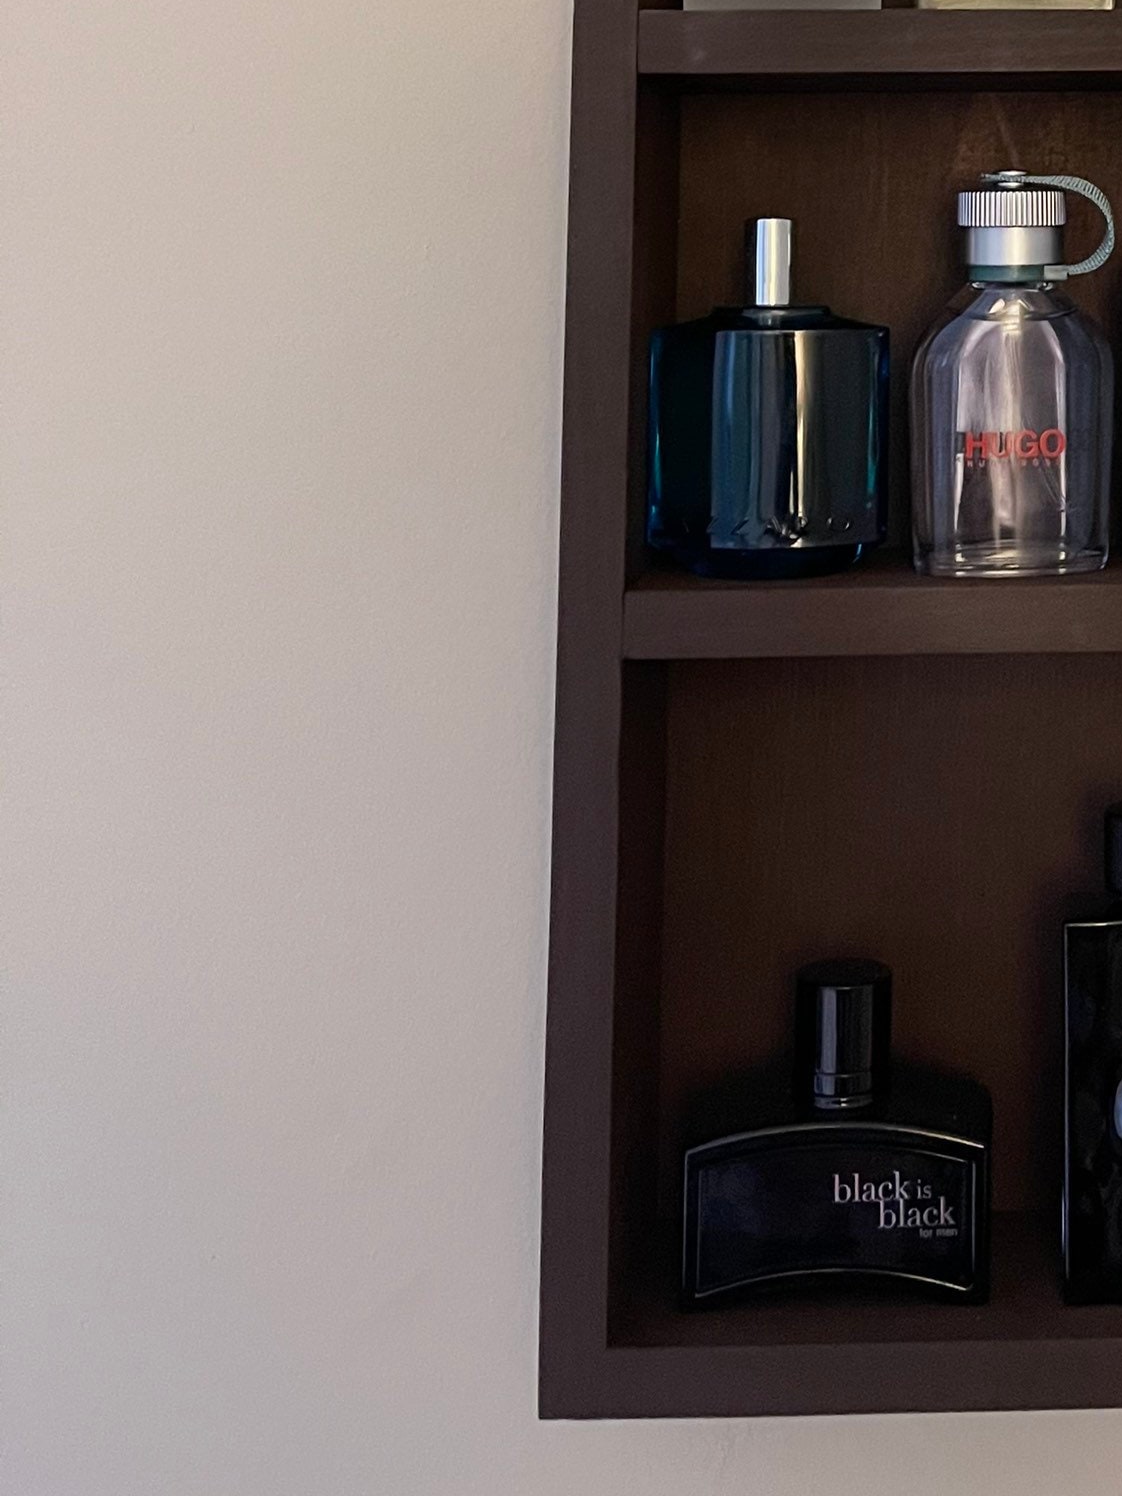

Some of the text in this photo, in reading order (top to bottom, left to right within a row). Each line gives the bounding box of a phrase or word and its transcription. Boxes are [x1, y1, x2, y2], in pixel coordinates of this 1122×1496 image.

[964, 428, 1067, 460] HUGO
[833, 1170, 932, 1203] black is
[878, 1196, 956, 1229] black
[919, 1228, 958, 1238] for men
